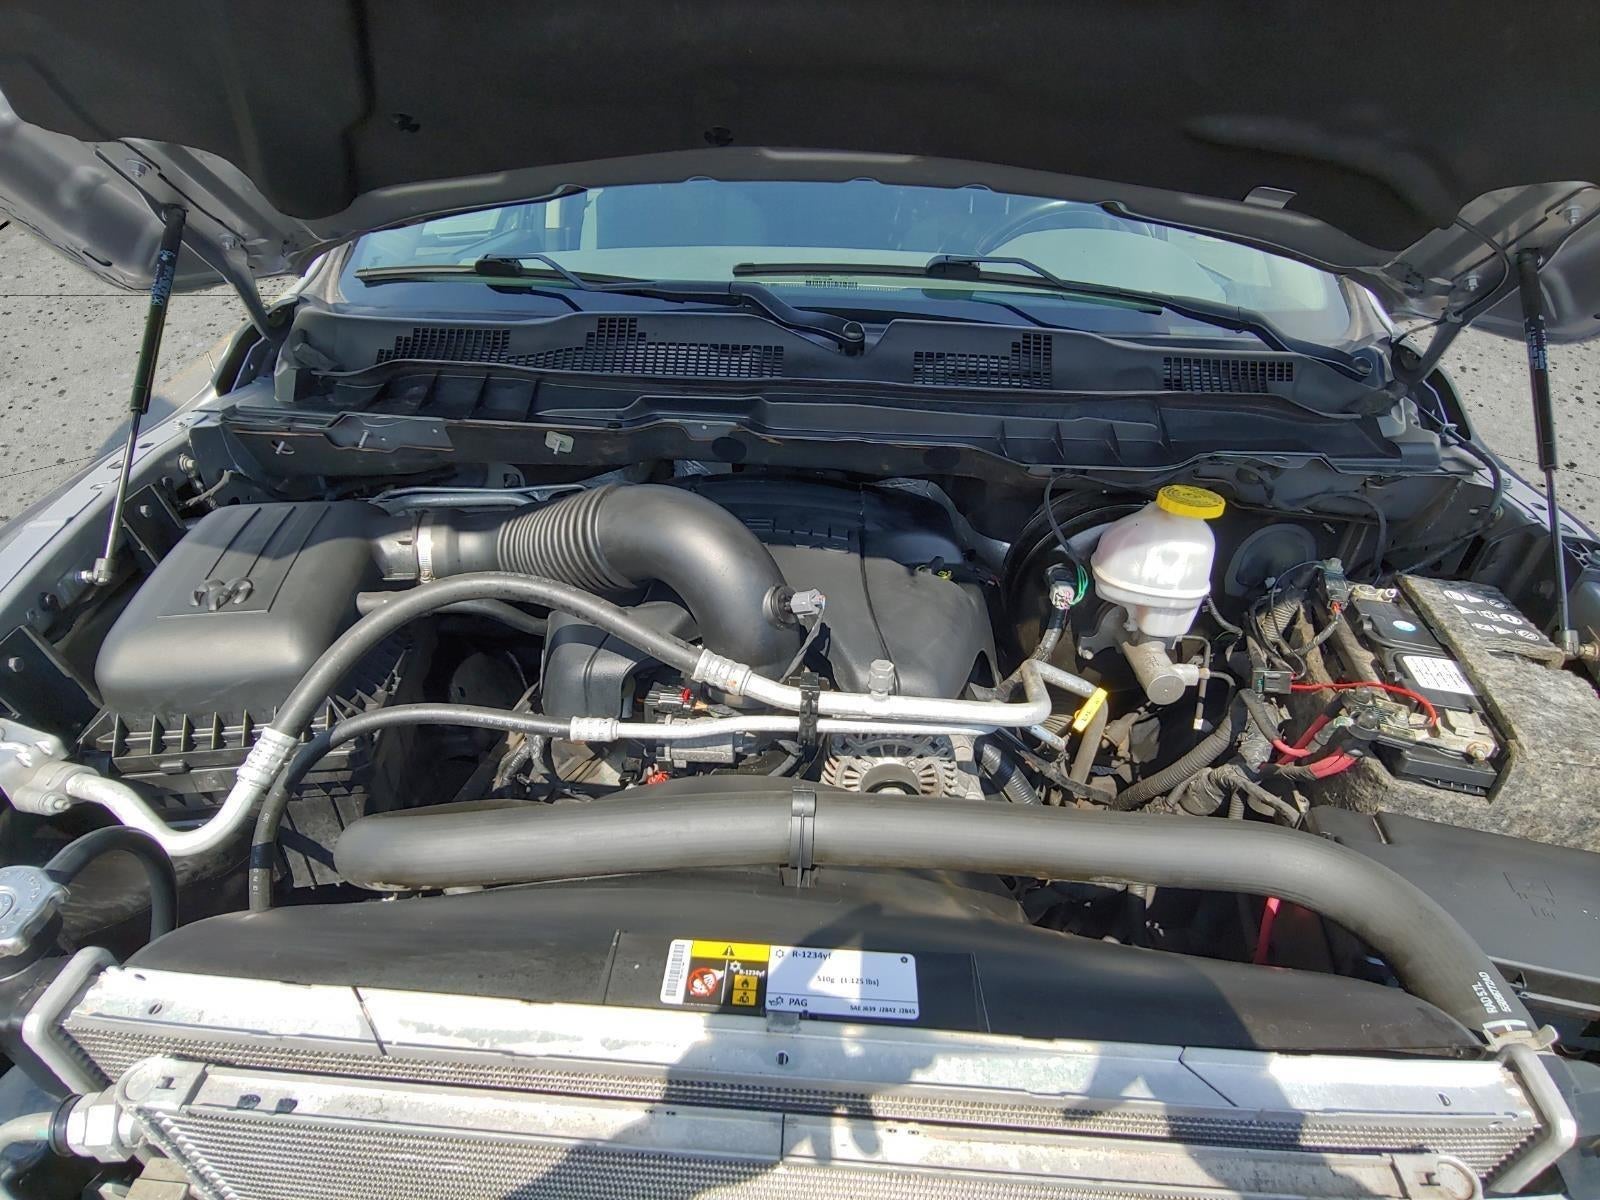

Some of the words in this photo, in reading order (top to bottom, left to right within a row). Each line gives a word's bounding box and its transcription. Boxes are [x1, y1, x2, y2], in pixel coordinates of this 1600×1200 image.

[792, 950, 832, 961] R-1234yf
[817, 975, 835, 984] 510g
[788, 997, 808, 1007] PAG
[1480, 996, 1499, 1014] RAD
